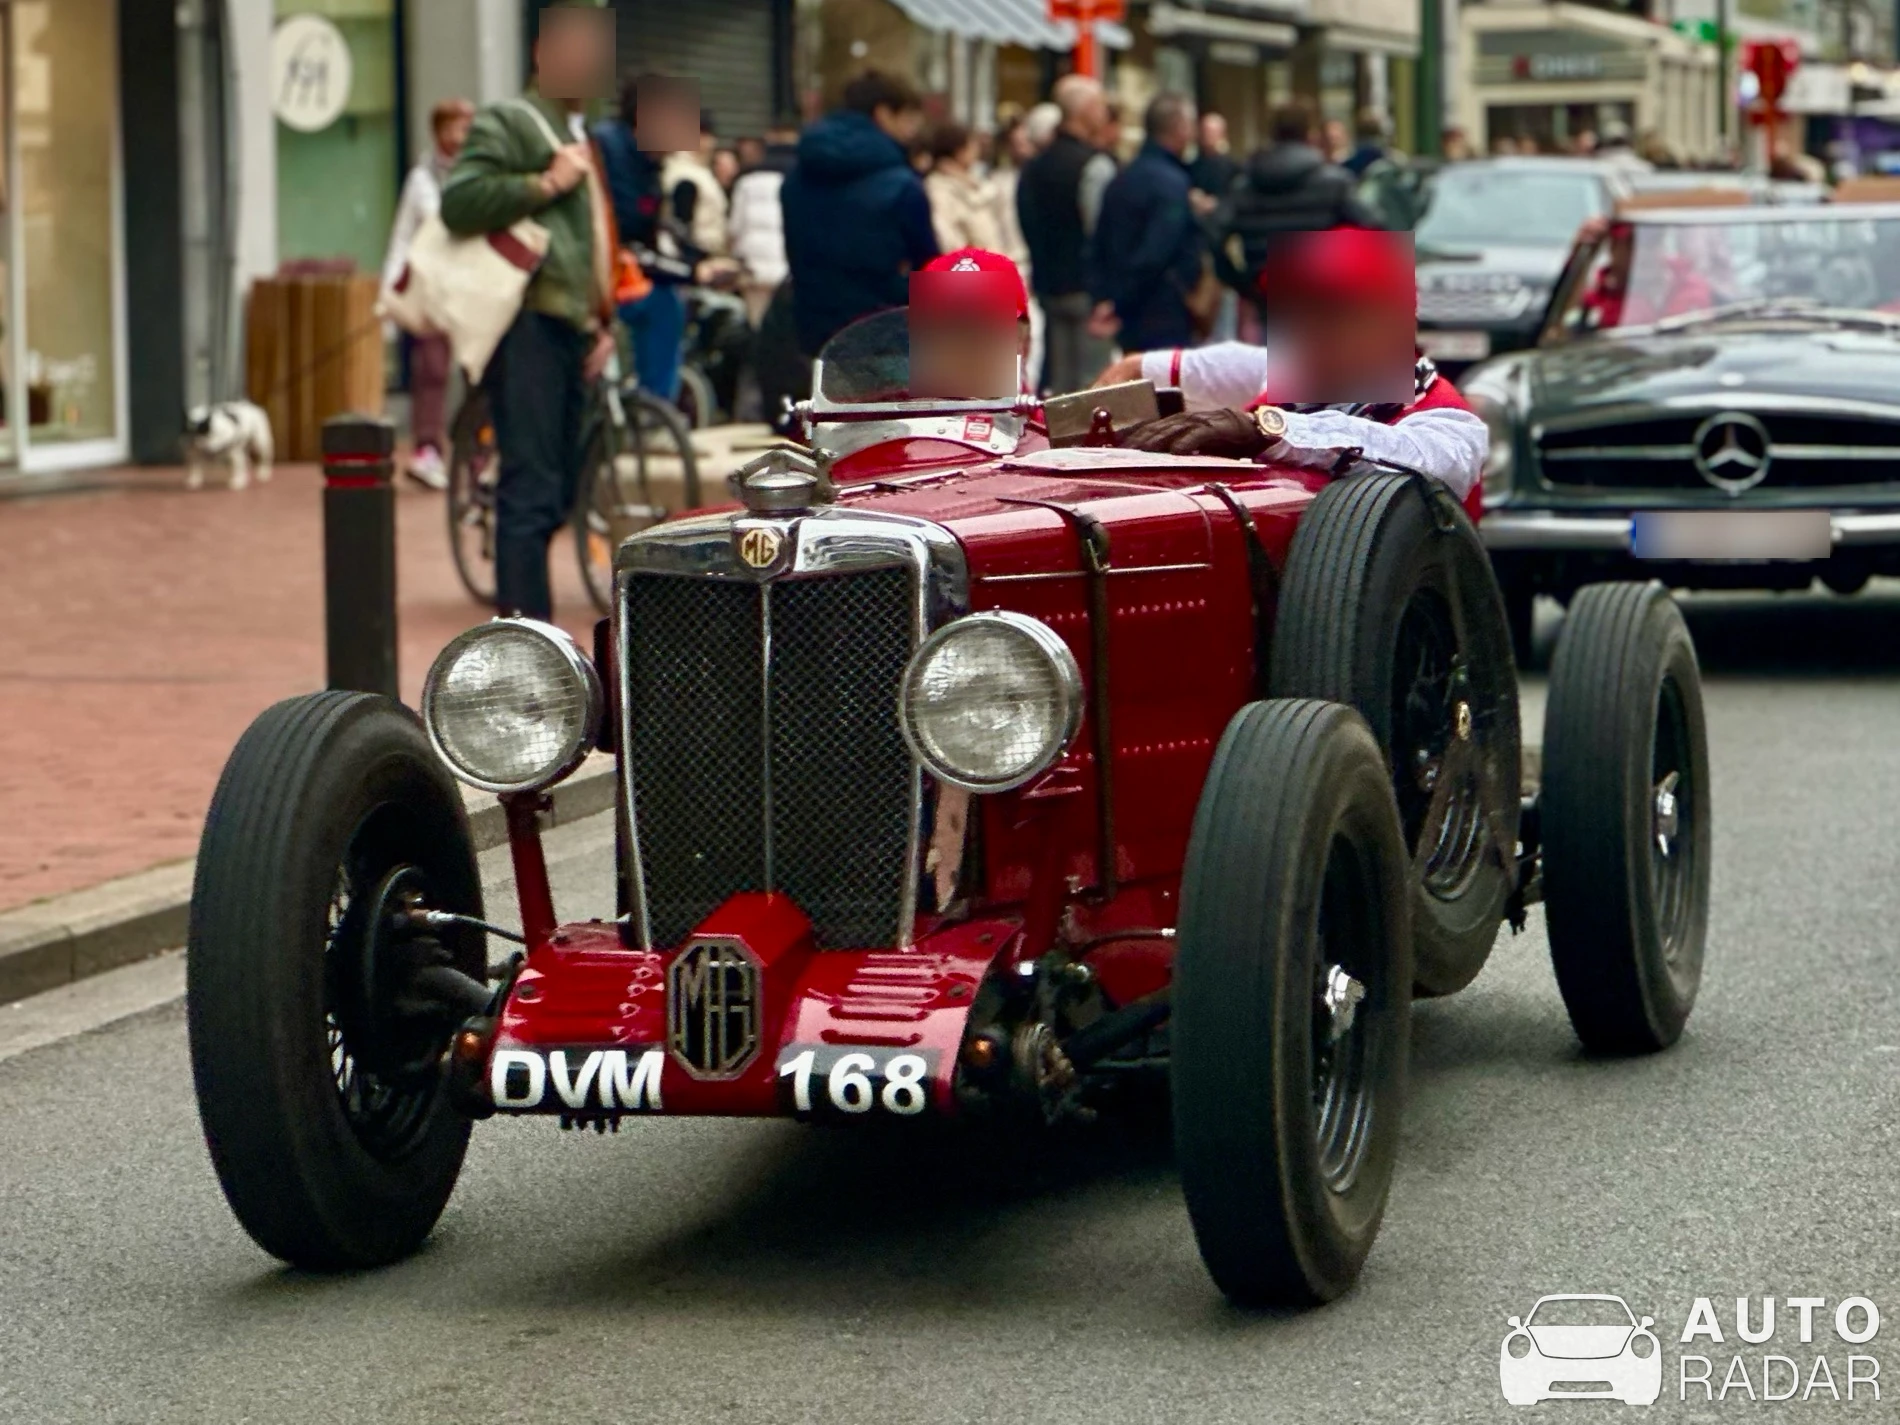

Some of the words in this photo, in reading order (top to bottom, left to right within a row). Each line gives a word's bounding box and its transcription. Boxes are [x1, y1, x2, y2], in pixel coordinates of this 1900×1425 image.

[744, 532, 775, 565] MG
[674, 944, 757, 1074] MG
[491, 1049, 664, 1110] DVM
[779, 1048, 928, 1115] 168
